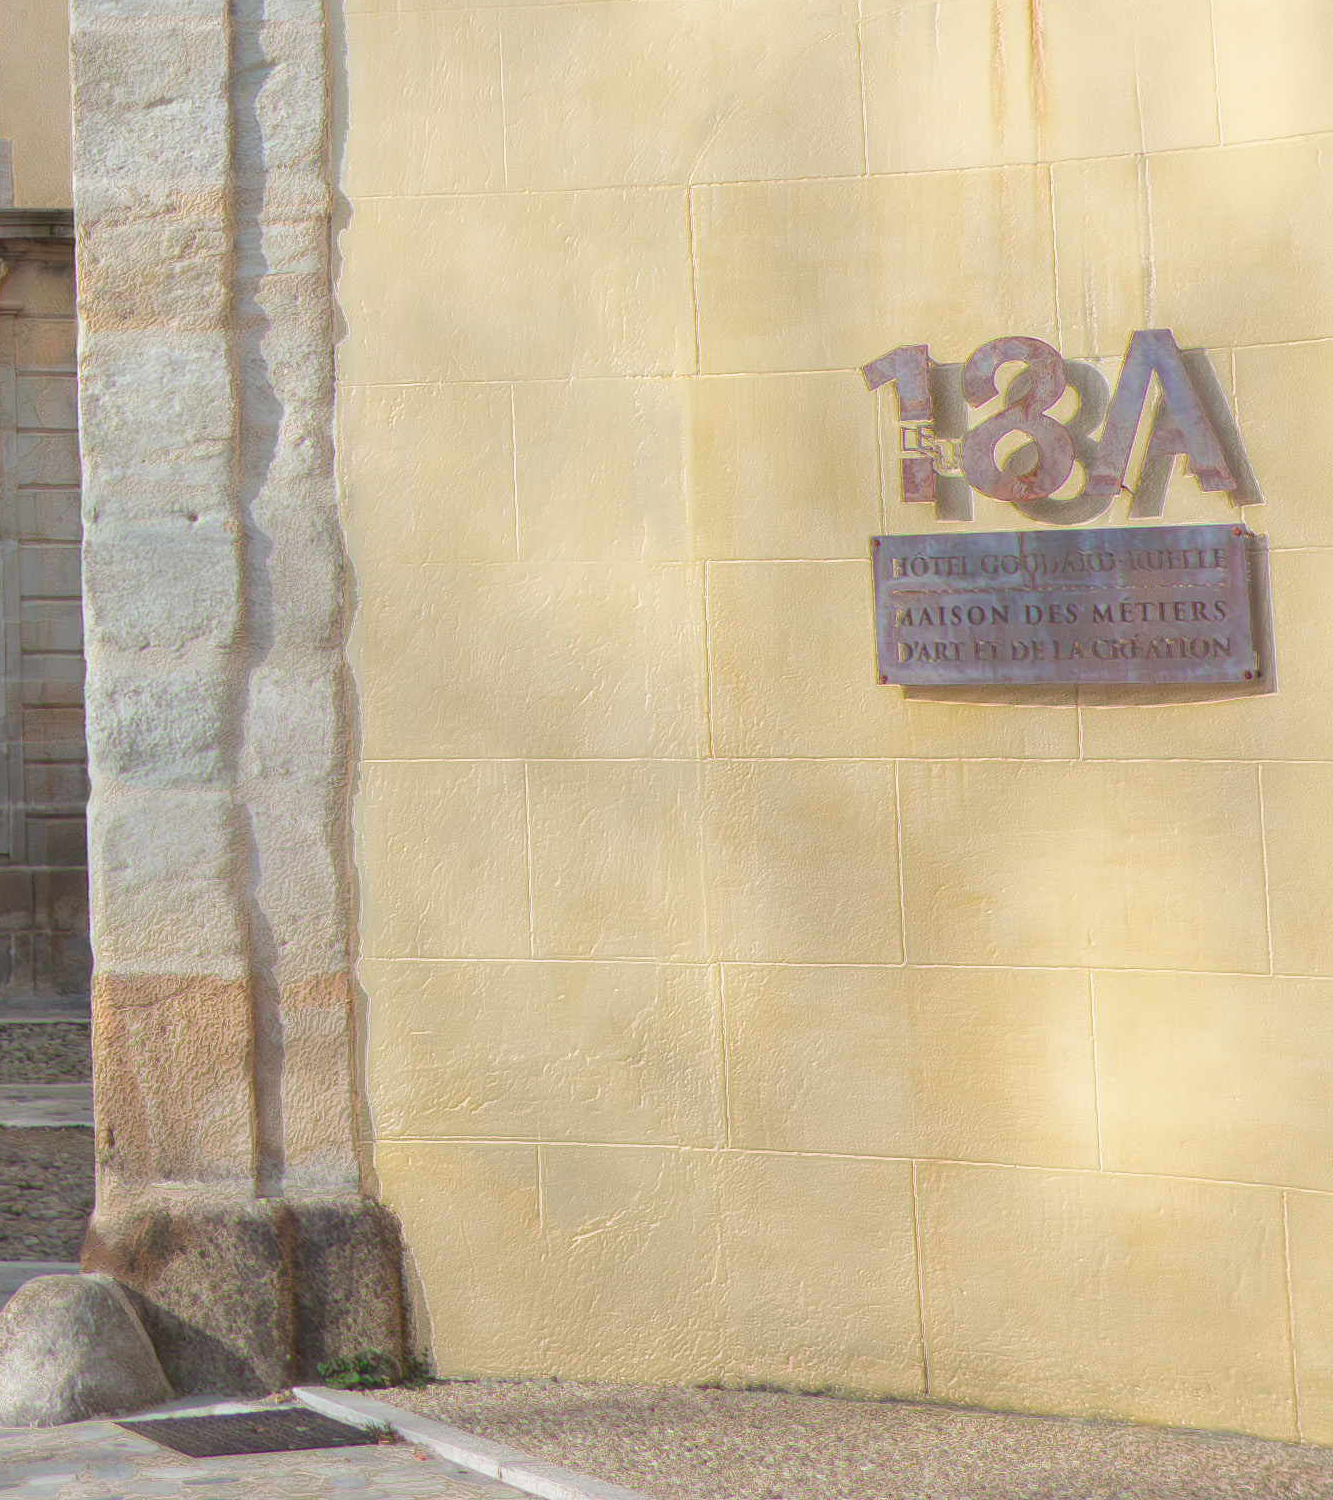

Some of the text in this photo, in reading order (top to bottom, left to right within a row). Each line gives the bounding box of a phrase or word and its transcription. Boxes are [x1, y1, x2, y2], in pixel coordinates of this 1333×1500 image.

[862, 329, 1237, 503] 18A
[893, 552, 975, 578] HÔTEL
[893, 597, 1227, 627] MAISON DES MÉTIERS
[896, 632, 1232, 664] D'ART ET DE LA CRÉATION
